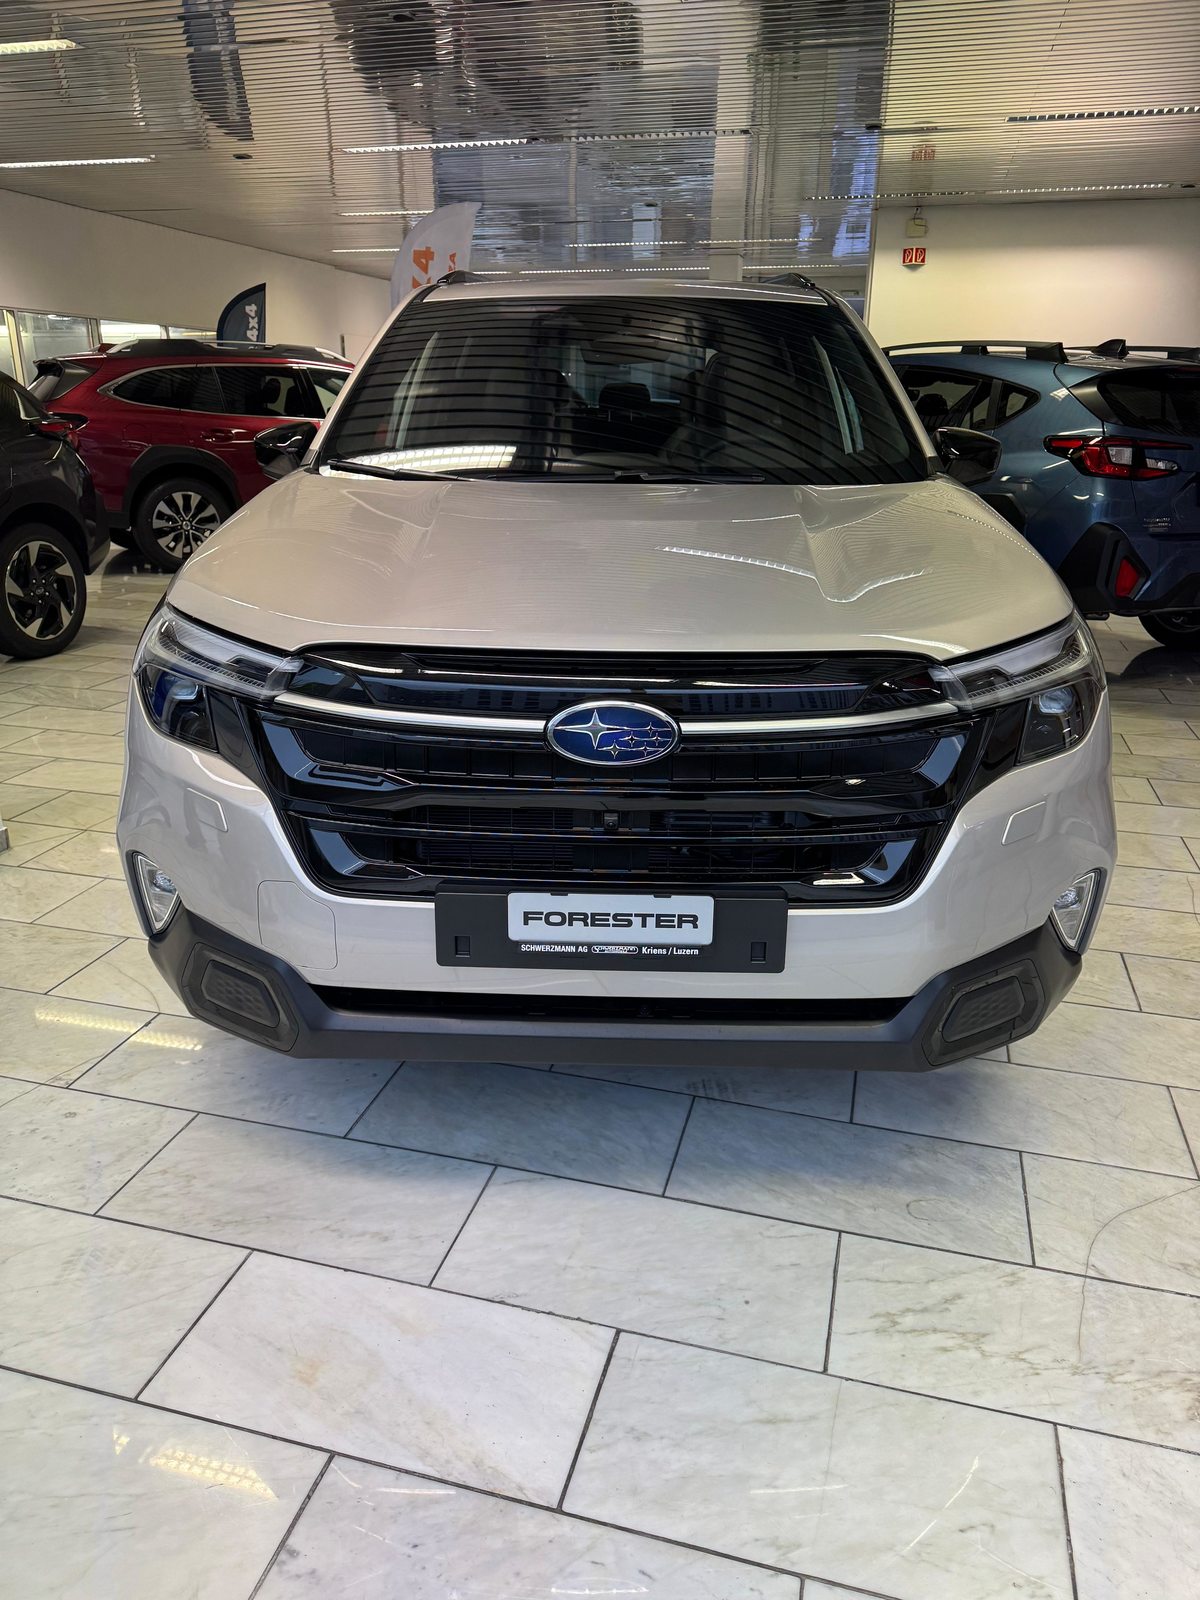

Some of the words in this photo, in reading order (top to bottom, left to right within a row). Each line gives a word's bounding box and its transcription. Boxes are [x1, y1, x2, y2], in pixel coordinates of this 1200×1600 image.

[522, 911, 699, 929] FORESTER
[520, 943, 576, 953] SCHWERZMANN
[577, 945, 588, 953] AG
[641, 946, 667, 955] Kriens
[673, 946, 699, 956] Luzern
